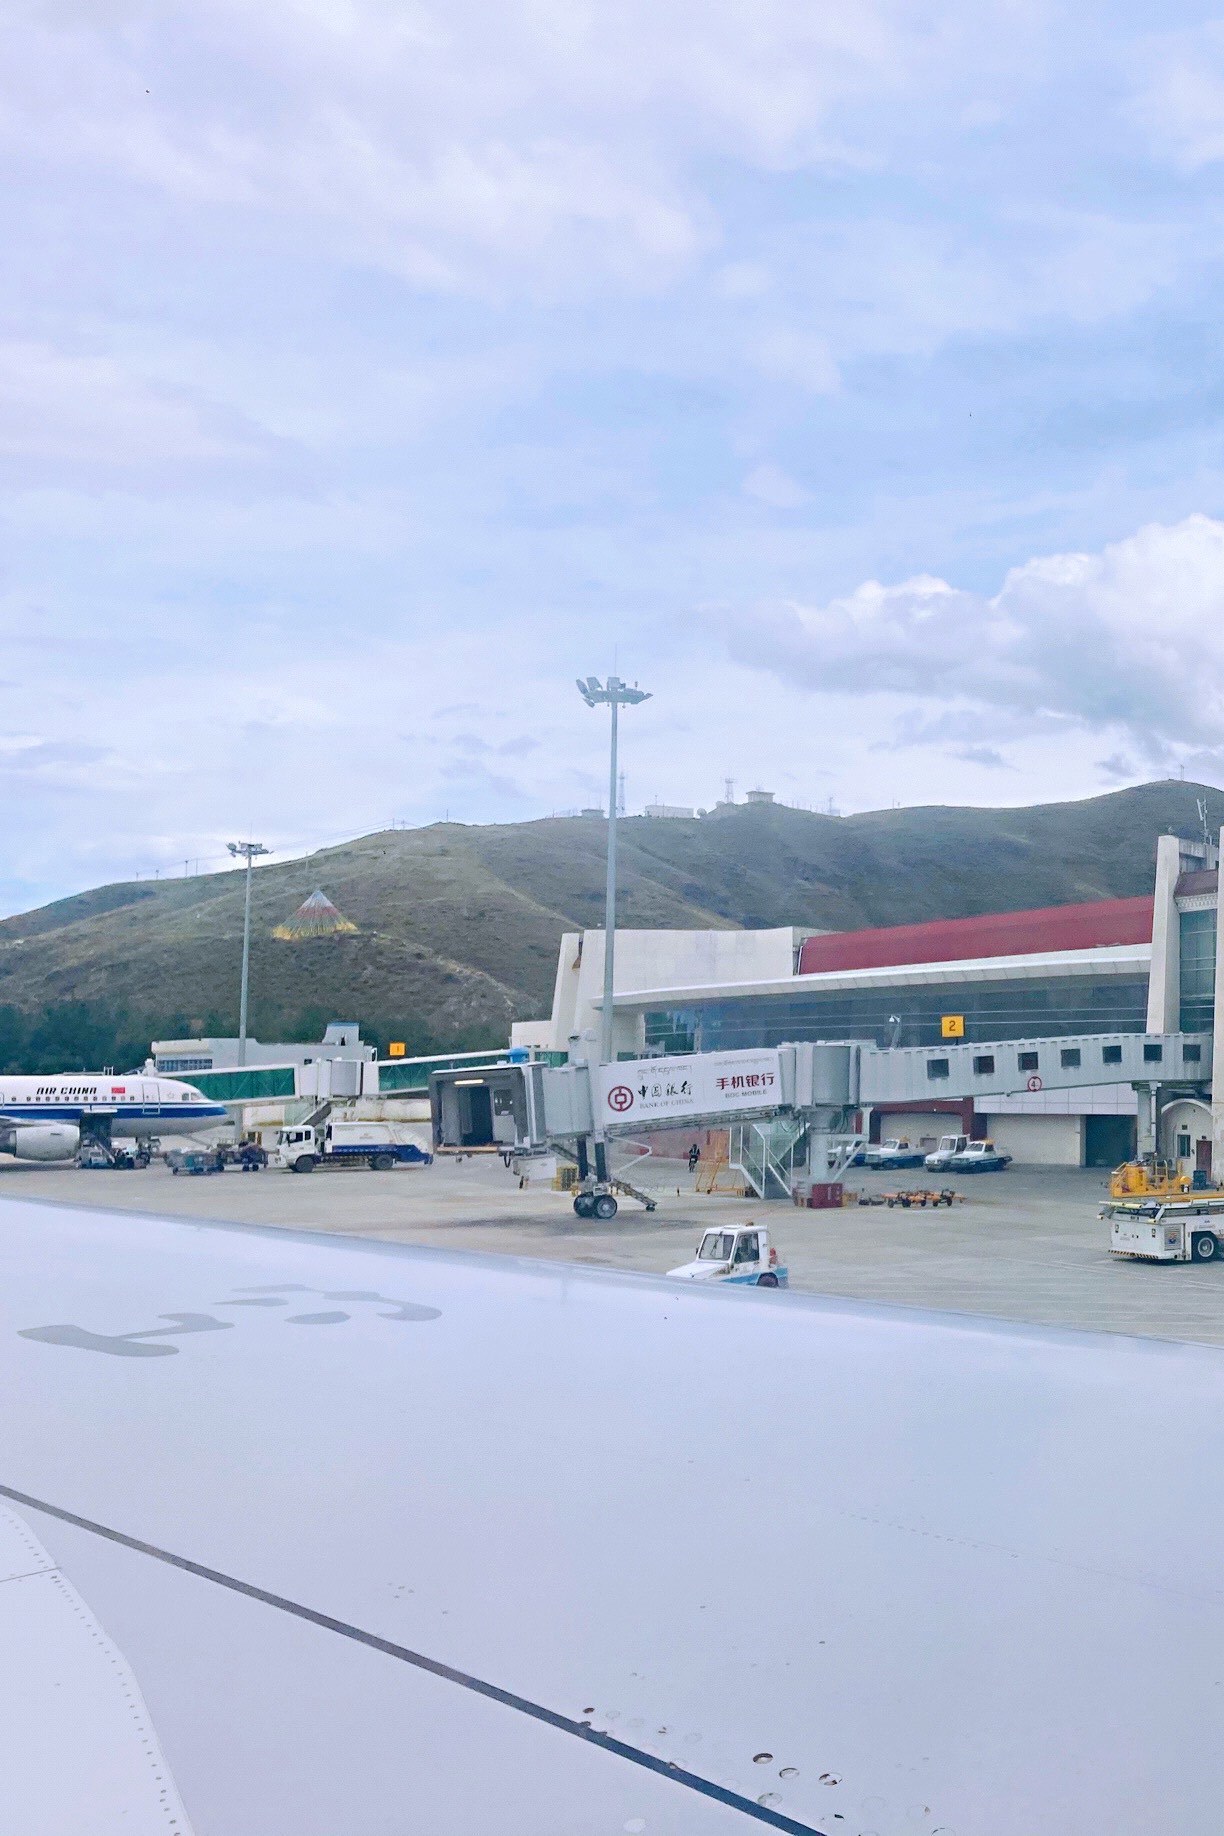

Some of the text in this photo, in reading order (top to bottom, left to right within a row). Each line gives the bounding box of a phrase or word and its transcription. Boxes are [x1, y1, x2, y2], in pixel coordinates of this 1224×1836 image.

[948, 1020, 956, 1032] 2
[716, 1072, 775, 1090] 手机银行
[36, 1087, 97, 1095] AIR CHINA
